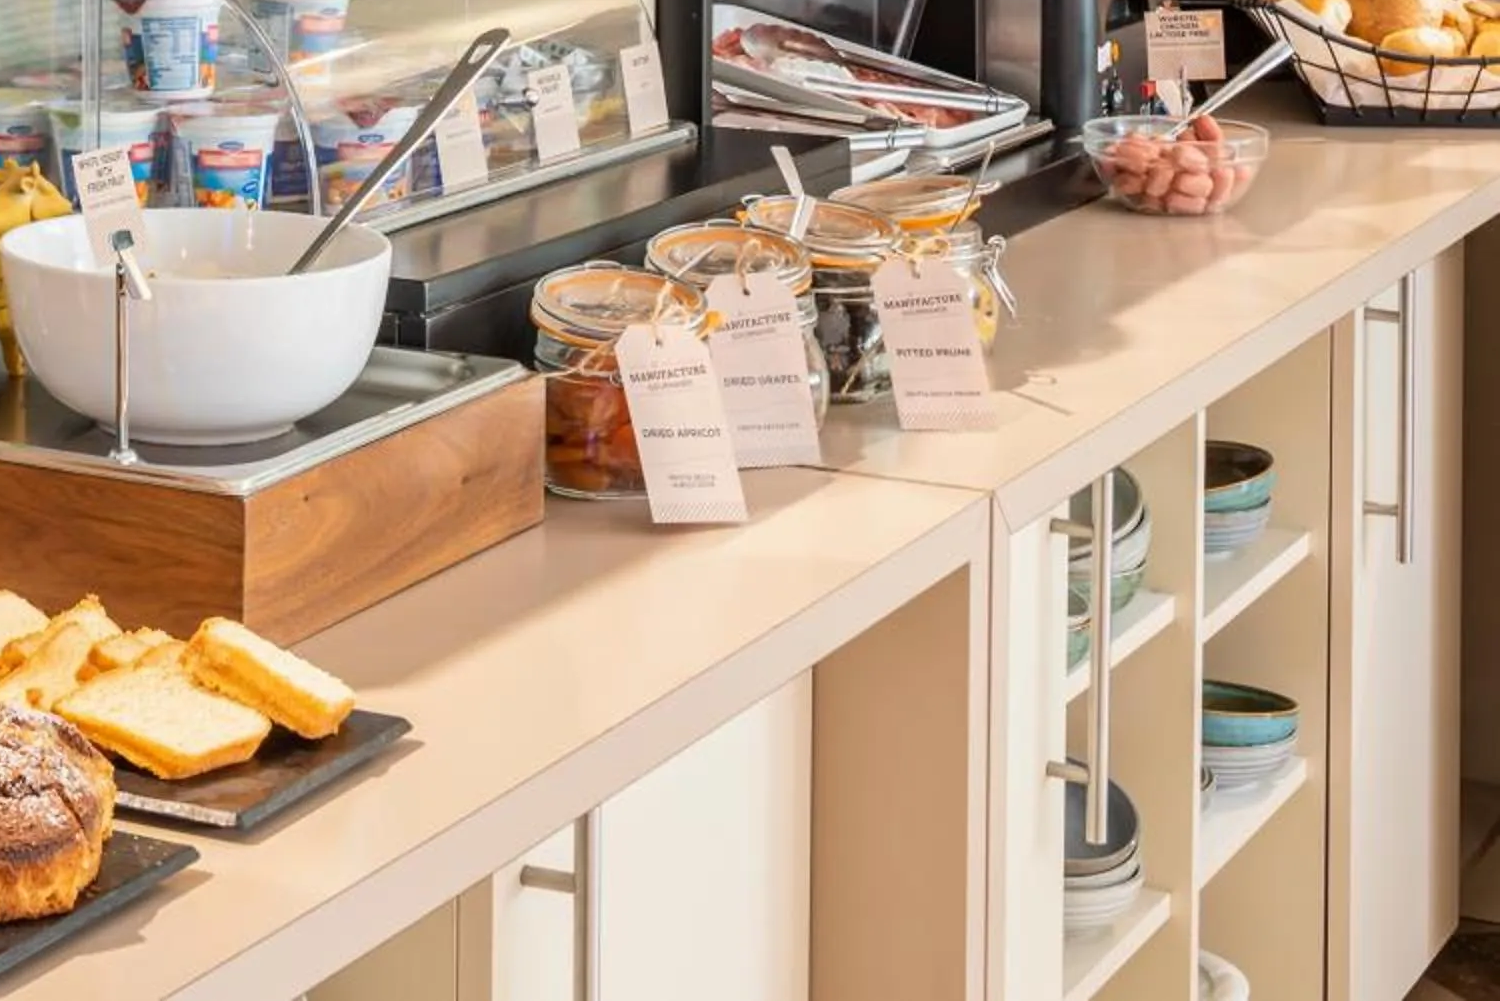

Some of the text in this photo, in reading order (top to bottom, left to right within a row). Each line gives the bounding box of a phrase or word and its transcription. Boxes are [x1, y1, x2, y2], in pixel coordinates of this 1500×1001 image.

[884, 293, 962, 310] MANUFACTURE
[722, 312, 792, 332] ANUFACTURE
[896, 348, 933, 358] PITTED
[629, 364, 707, 383] MANUFACTURE
[723, 375, 800, 387] DRIED GRAPES
[641, 427, 721, 439] DRIED APRICOT
